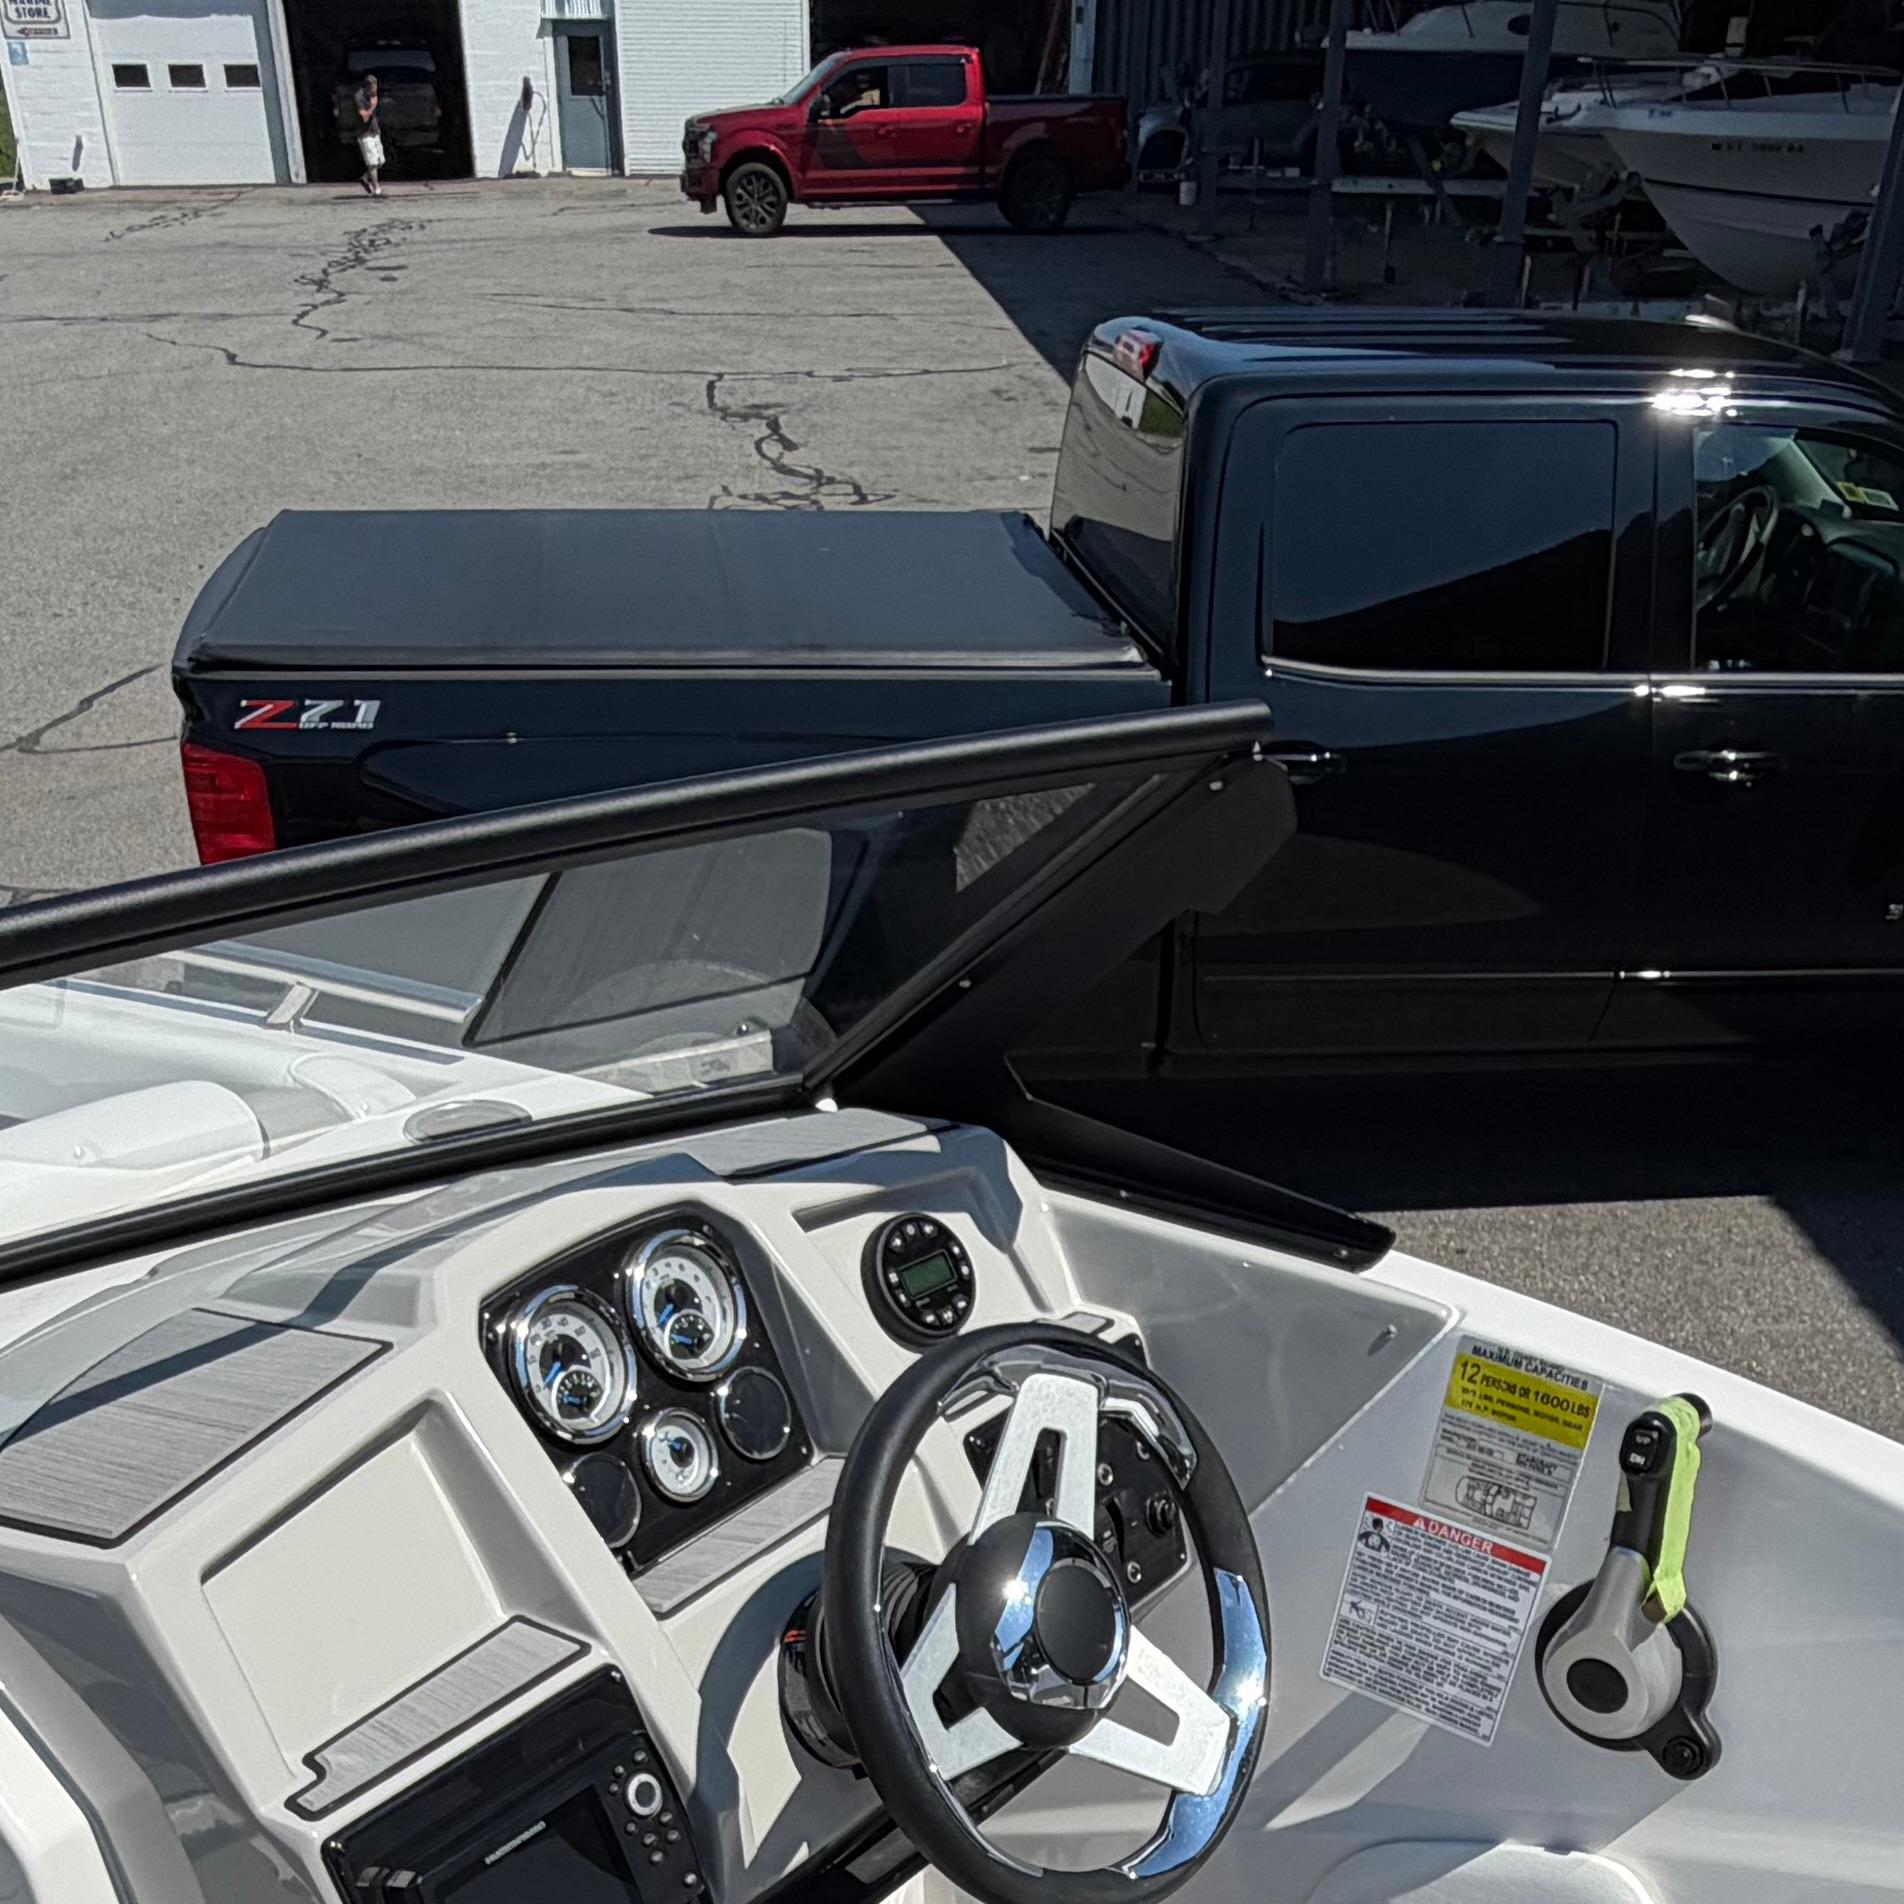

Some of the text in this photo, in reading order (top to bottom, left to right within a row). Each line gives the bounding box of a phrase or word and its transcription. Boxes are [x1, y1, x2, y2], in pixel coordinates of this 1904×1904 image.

[14, 7, 51, 19] STORE
[234, 699, 381, 729] Z71
[1471, 1345, 1589, 1391] MAXIMUM CAPACITIES
[1460, 1359, 1482, 1386] 12
[1571, 1401, 1591, 1419] LBS
[1629, 1452, 1646, 1465] DN
[1427, 1520, 1494, 1554] DANGER
